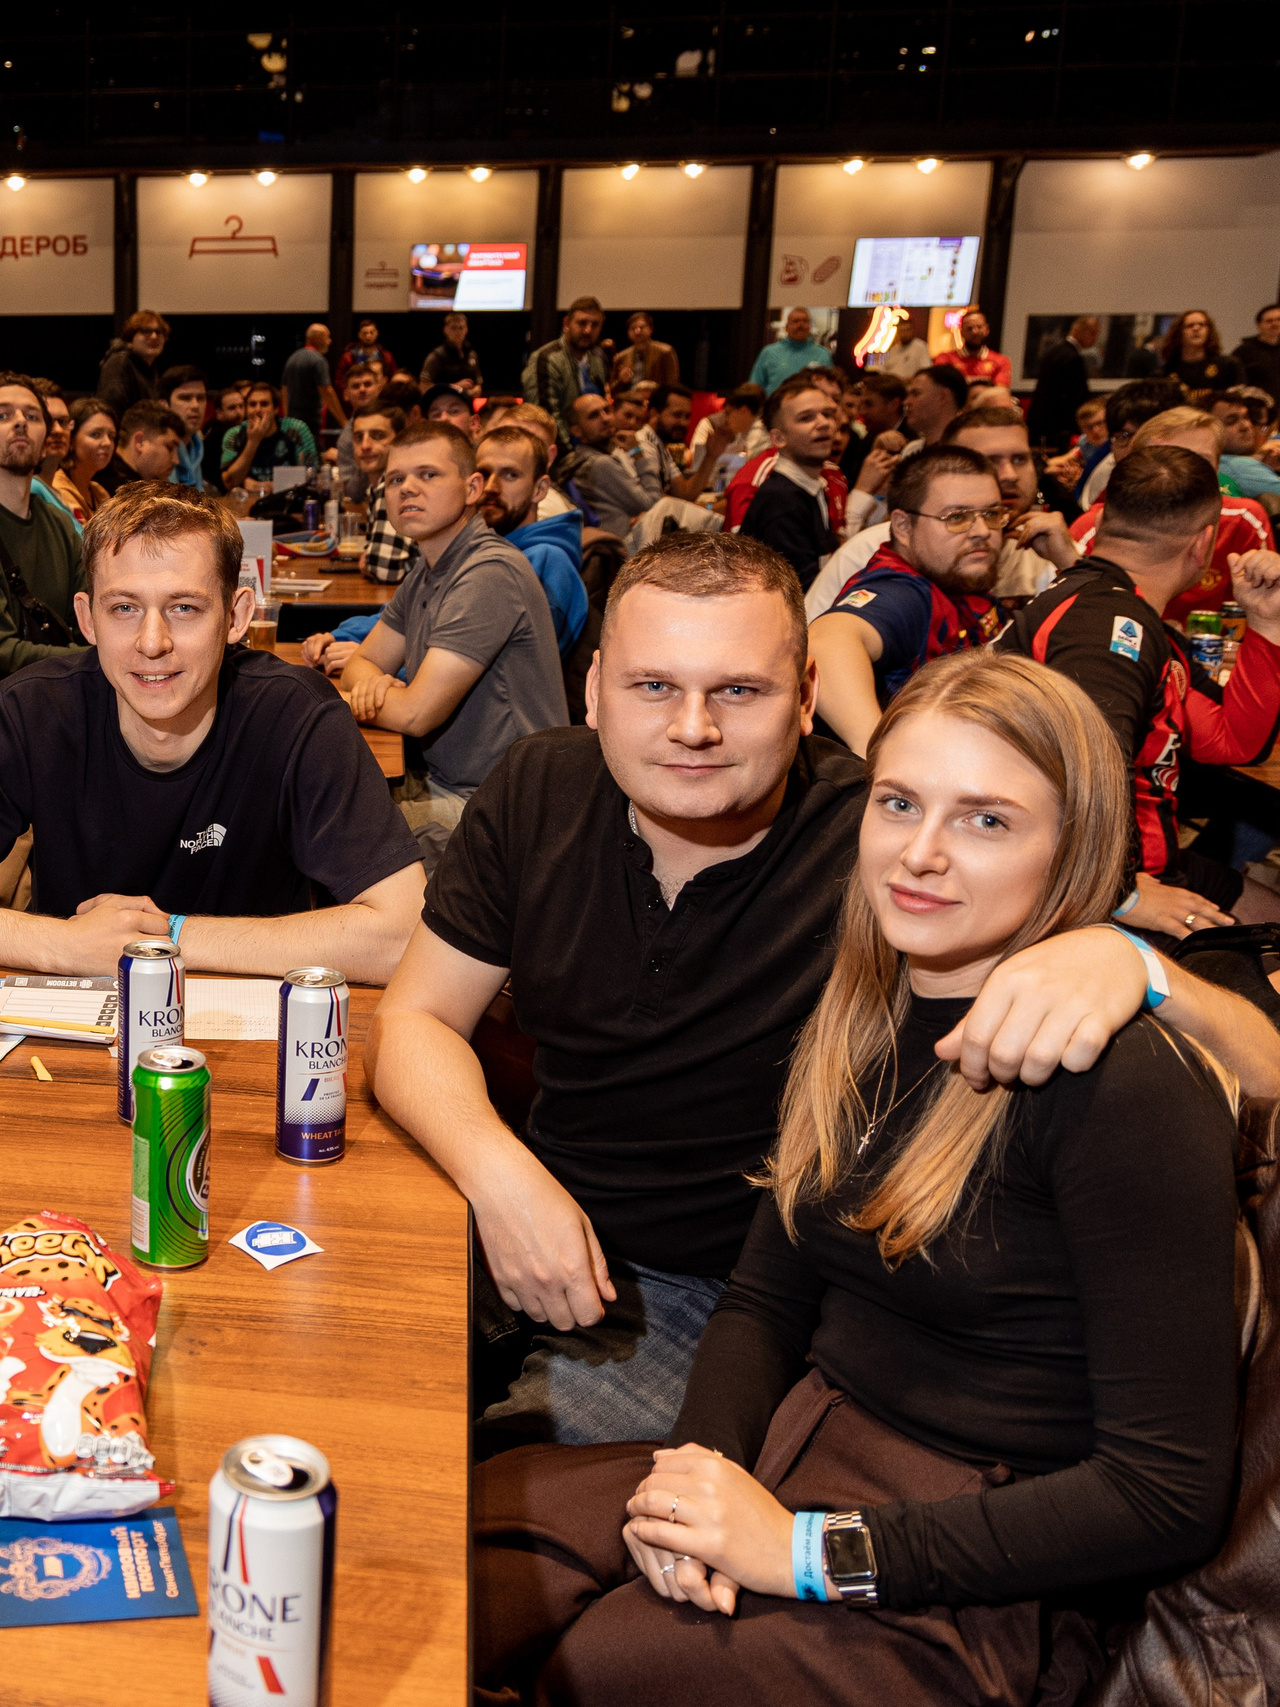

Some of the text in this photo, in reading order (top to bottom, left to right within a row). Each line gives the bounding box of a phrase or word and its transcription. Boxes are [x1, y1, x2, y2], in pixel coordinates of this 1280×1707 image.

[180, 831, 214, 849] NORTH
[196, 824, 214, 839] THE
[190, 839, 214, 855] FACE
[139, 1005, 184, 1027] KRON
[152, 1025, 183, 1038] BLANC
[296, 1037, 348, 1059] KRON
[301, 1128, 345, 1140] WHEAT TAS
[803, 1512, 815, 1579] Достаём двойн
[210, 1563, 302, 1624] ONE
